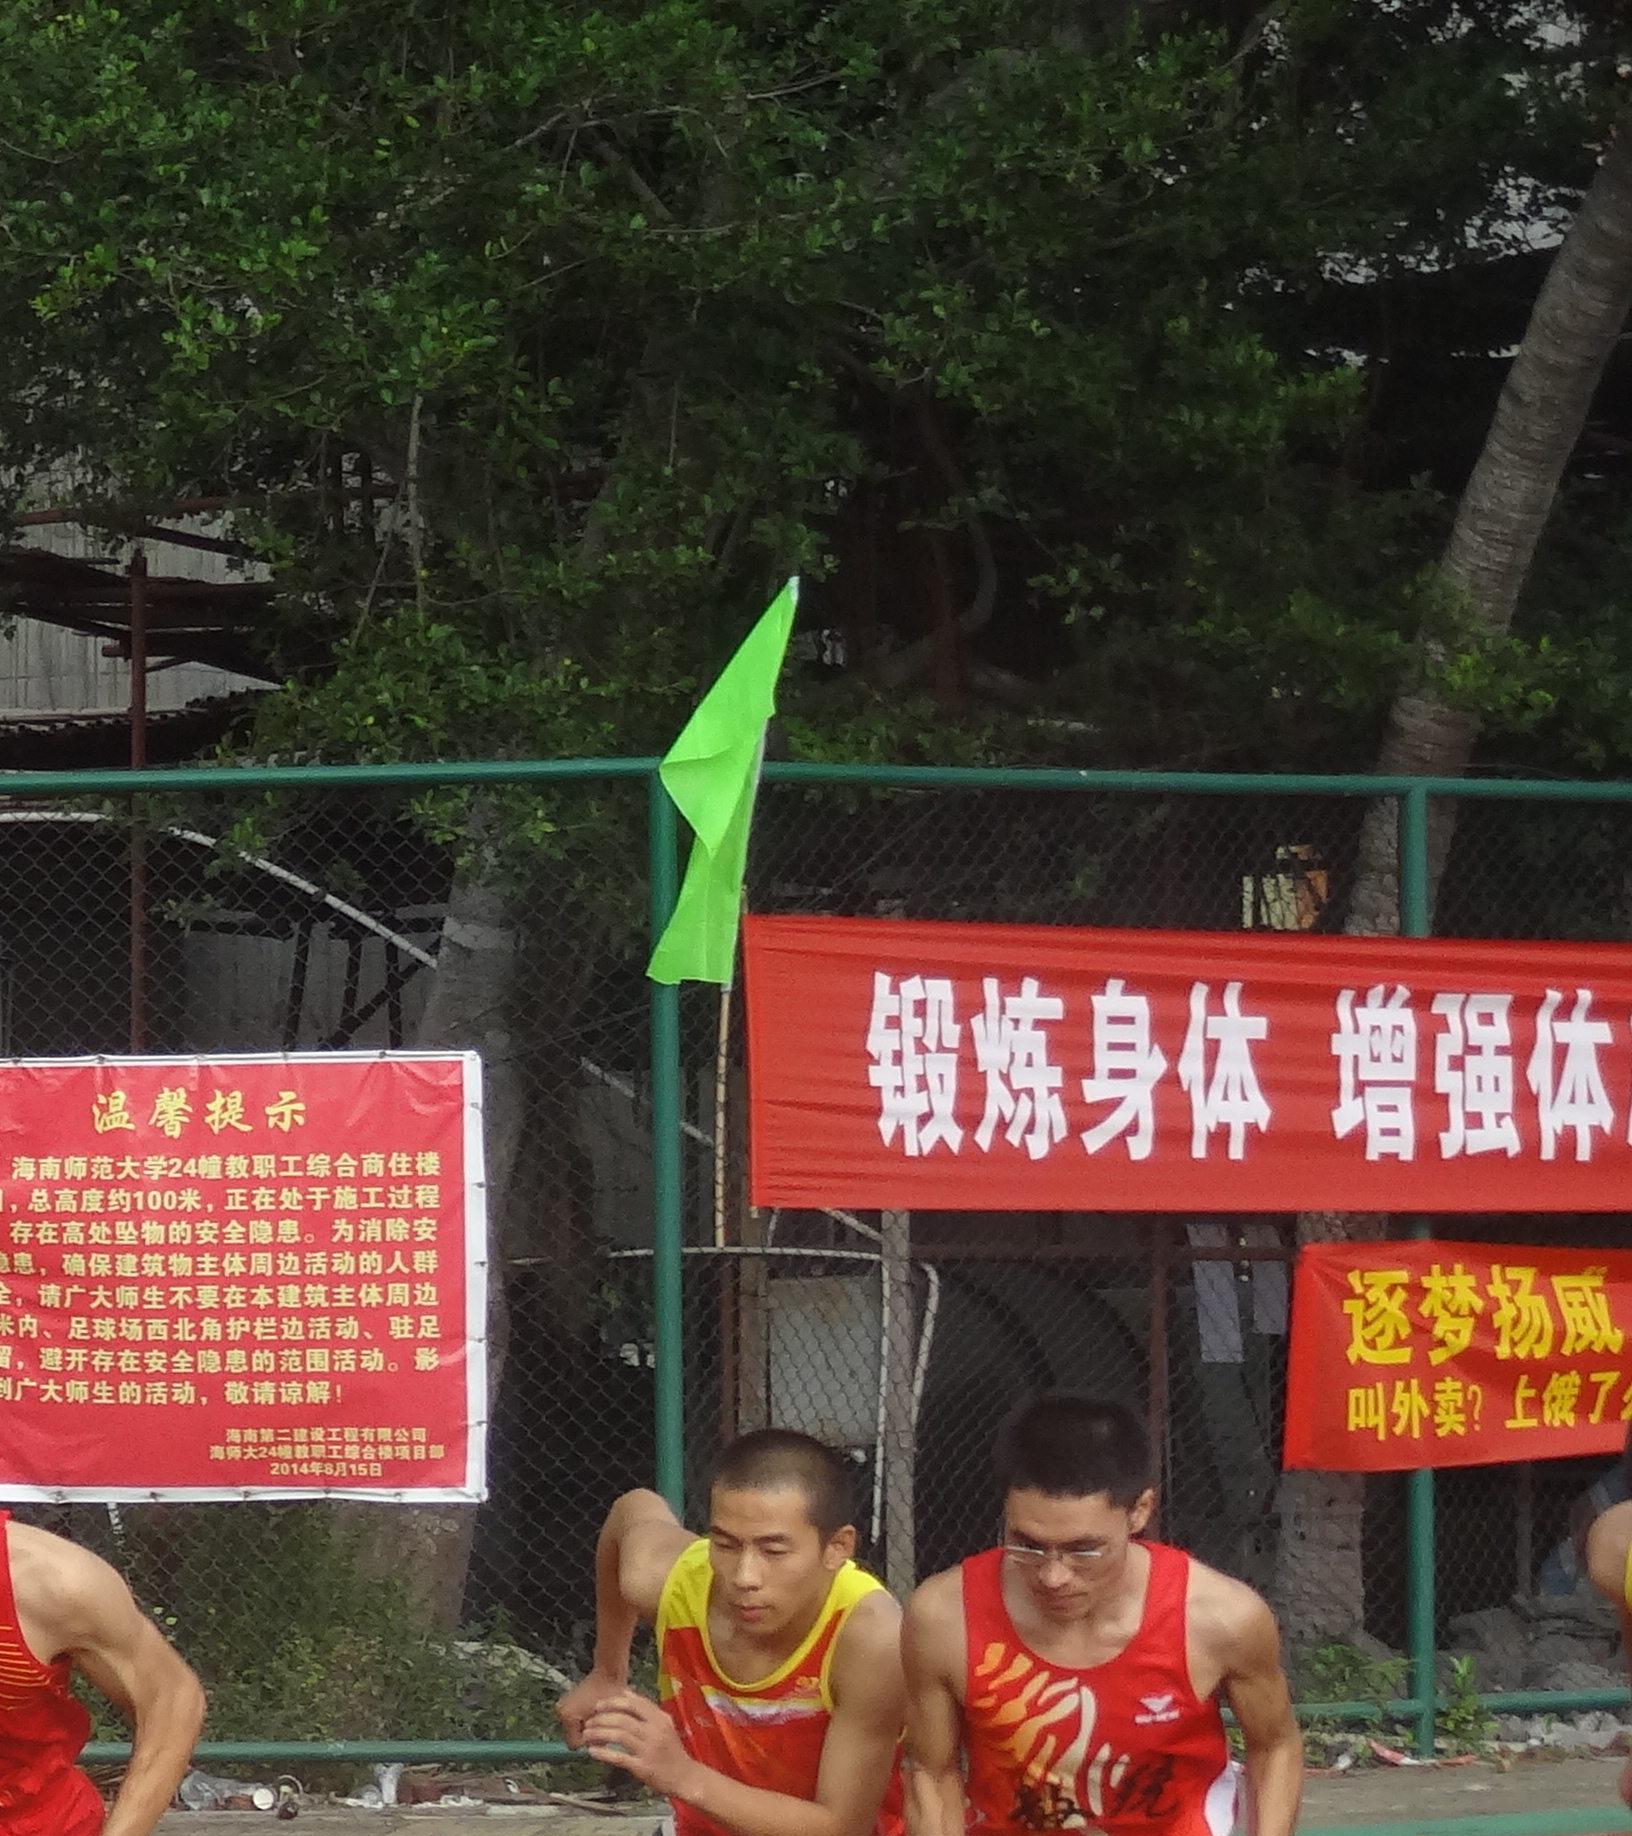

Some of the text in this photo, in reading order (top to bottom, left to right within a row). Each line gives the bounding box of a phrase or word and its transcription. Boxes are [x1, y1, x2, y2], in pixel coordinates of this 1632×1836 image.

[866, 971, 1632, 1162] 锻炼身体 增强体
[92, 1087, 307, 1138] 温馨提示
[12, 1152, 441, 1180] 海南师范大学24幢教职工综合商住楼
[1343, 1264, 1625, 1366] 逐梦扬威
[225, 1427, 427, 1443] 海南第二建设工程有限公司
[270, 1462, 383, 1477] 2014年8月15日
